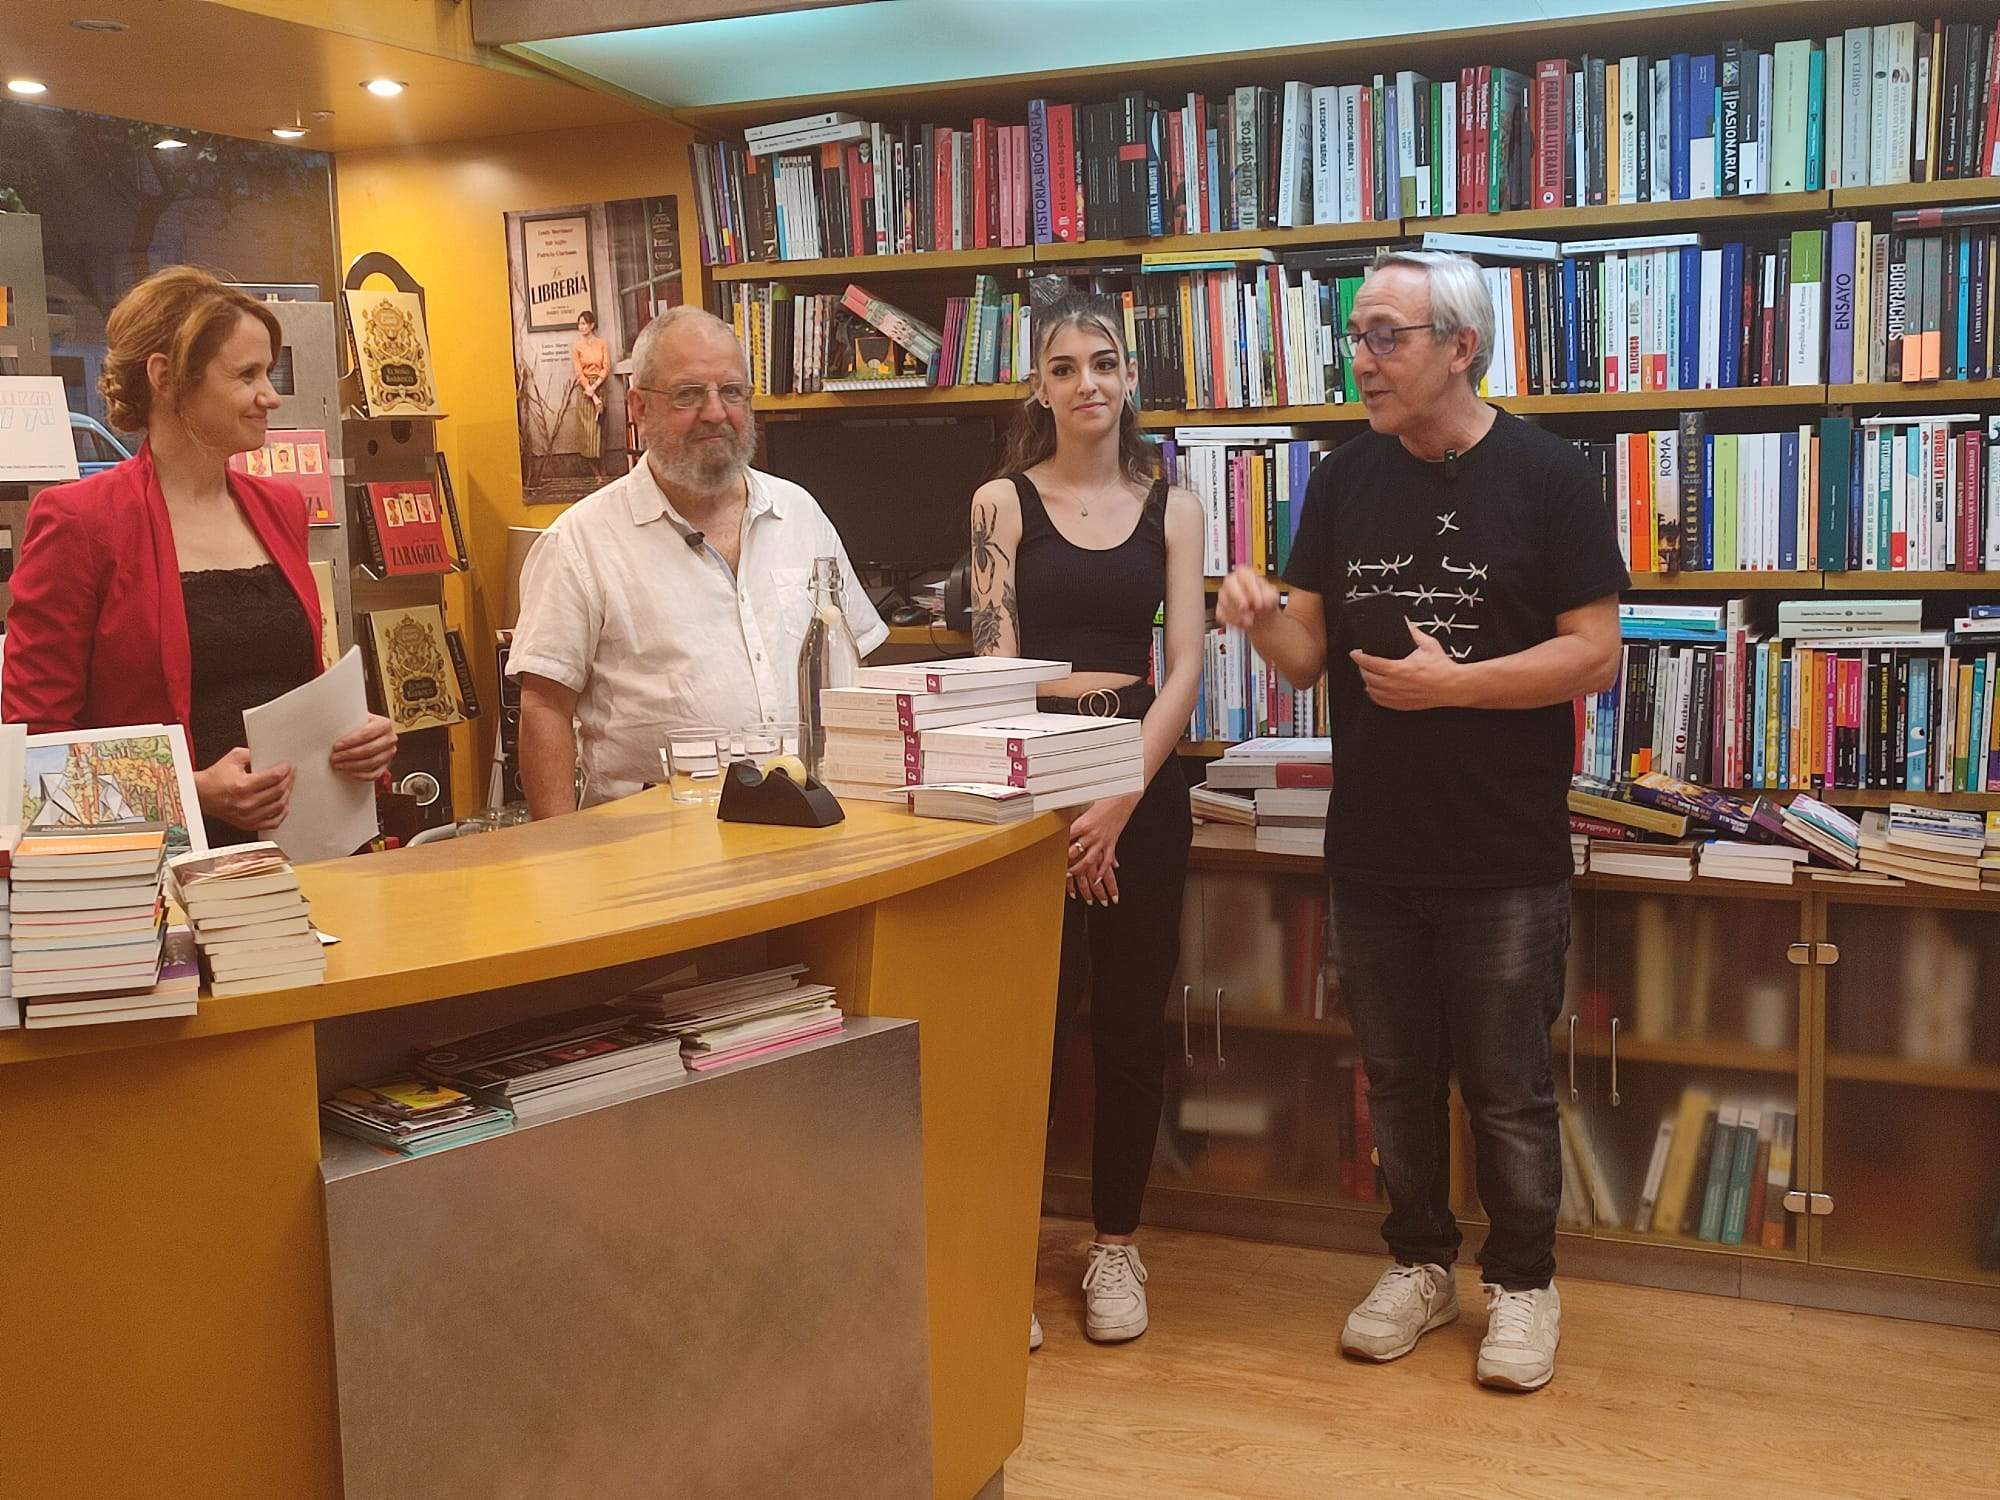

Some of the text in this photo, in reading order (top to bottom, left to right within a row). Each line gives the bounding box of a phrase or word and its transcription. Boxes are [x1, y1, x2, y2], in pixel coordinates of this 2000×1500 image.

[1851, 41, 1862, 97] GRIJELMO
[1545, 134, 1559, 187] LITERARIO
[1724, 100, 1737, 180] PASIONARIA
[531, 271, 588, 305] LIBRERÍA
[1834, 273, 1851, 330] ENSAYO
[1888, 263, 1906, 341] BORRACHOS
[1798, 324, 1808, 355] República
[1799, 315, 1806, 323] de
[1798, 356, 1805, 364] La
[1659, 437, 1672, 477] ROMA
[1934, 429, 1946, 479] LA RETIRADA
[391, 543, 445, 566] ZARAGOZA
